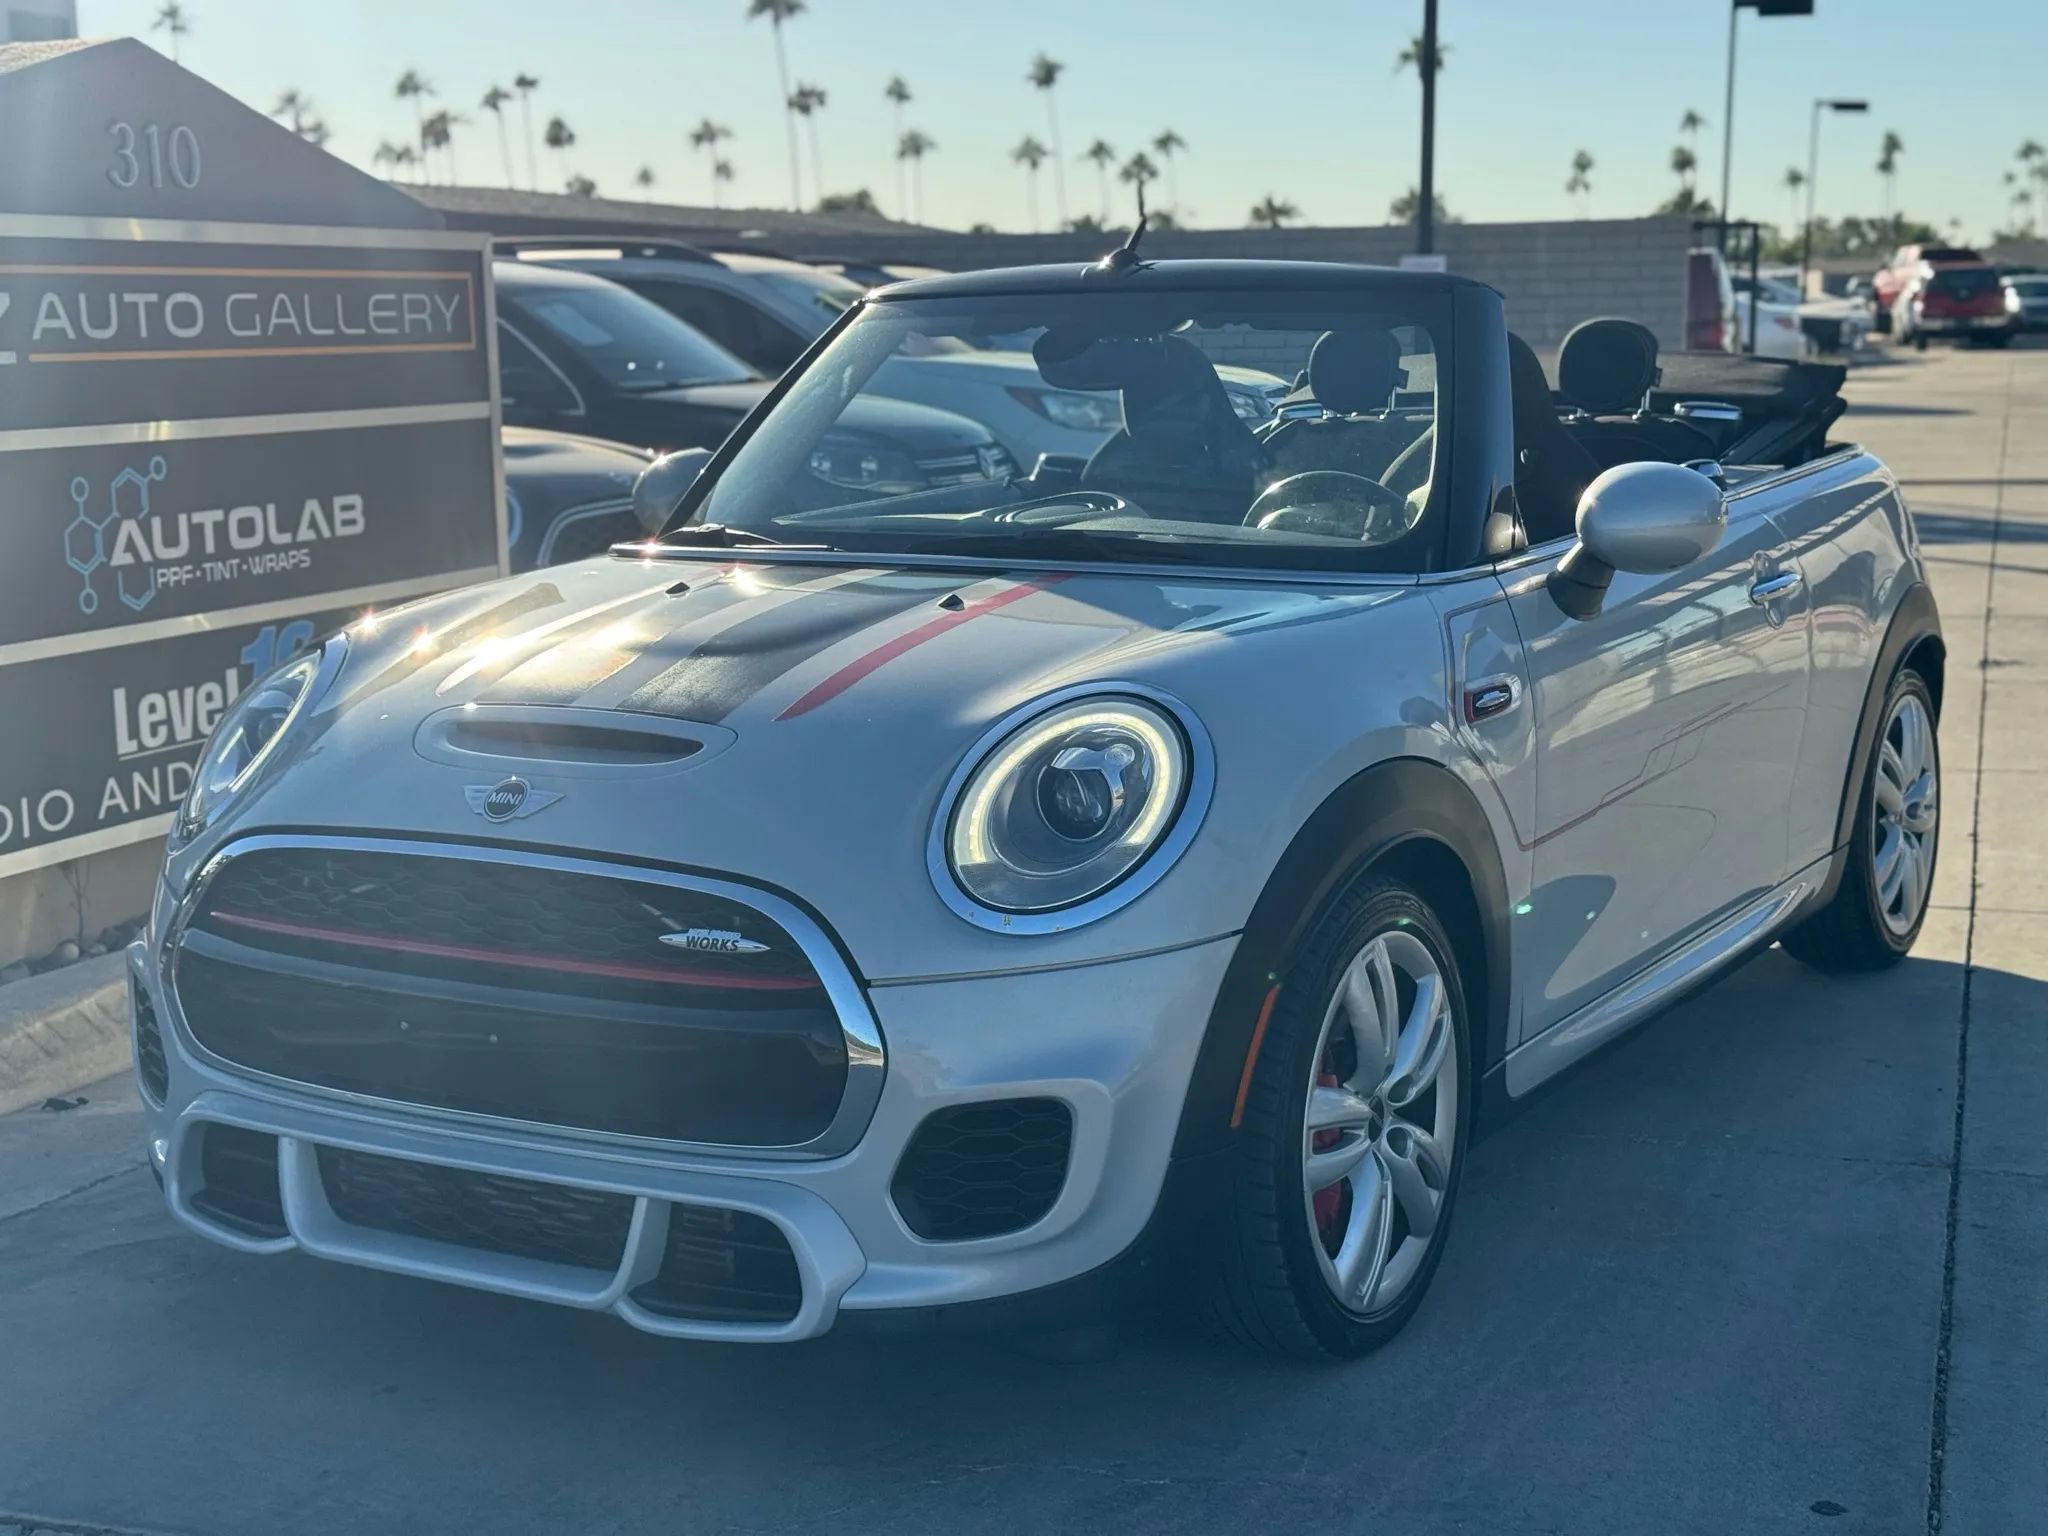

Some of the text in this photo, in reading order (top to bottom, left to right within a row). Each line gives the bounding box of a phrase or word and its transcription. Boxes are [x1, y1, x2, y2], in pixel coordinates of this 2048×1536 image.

[108, 121, 201, 189] 310
[32, 291, 204, 340] AUTO
[225, 292, 460, 337] GALLERY
[110, 494, 365, 567] AUTOLAB
[98, 762, 192, 820] AND
[488, 791, 522, 805] MINI
[686, 935, 739, 951] WORKS
